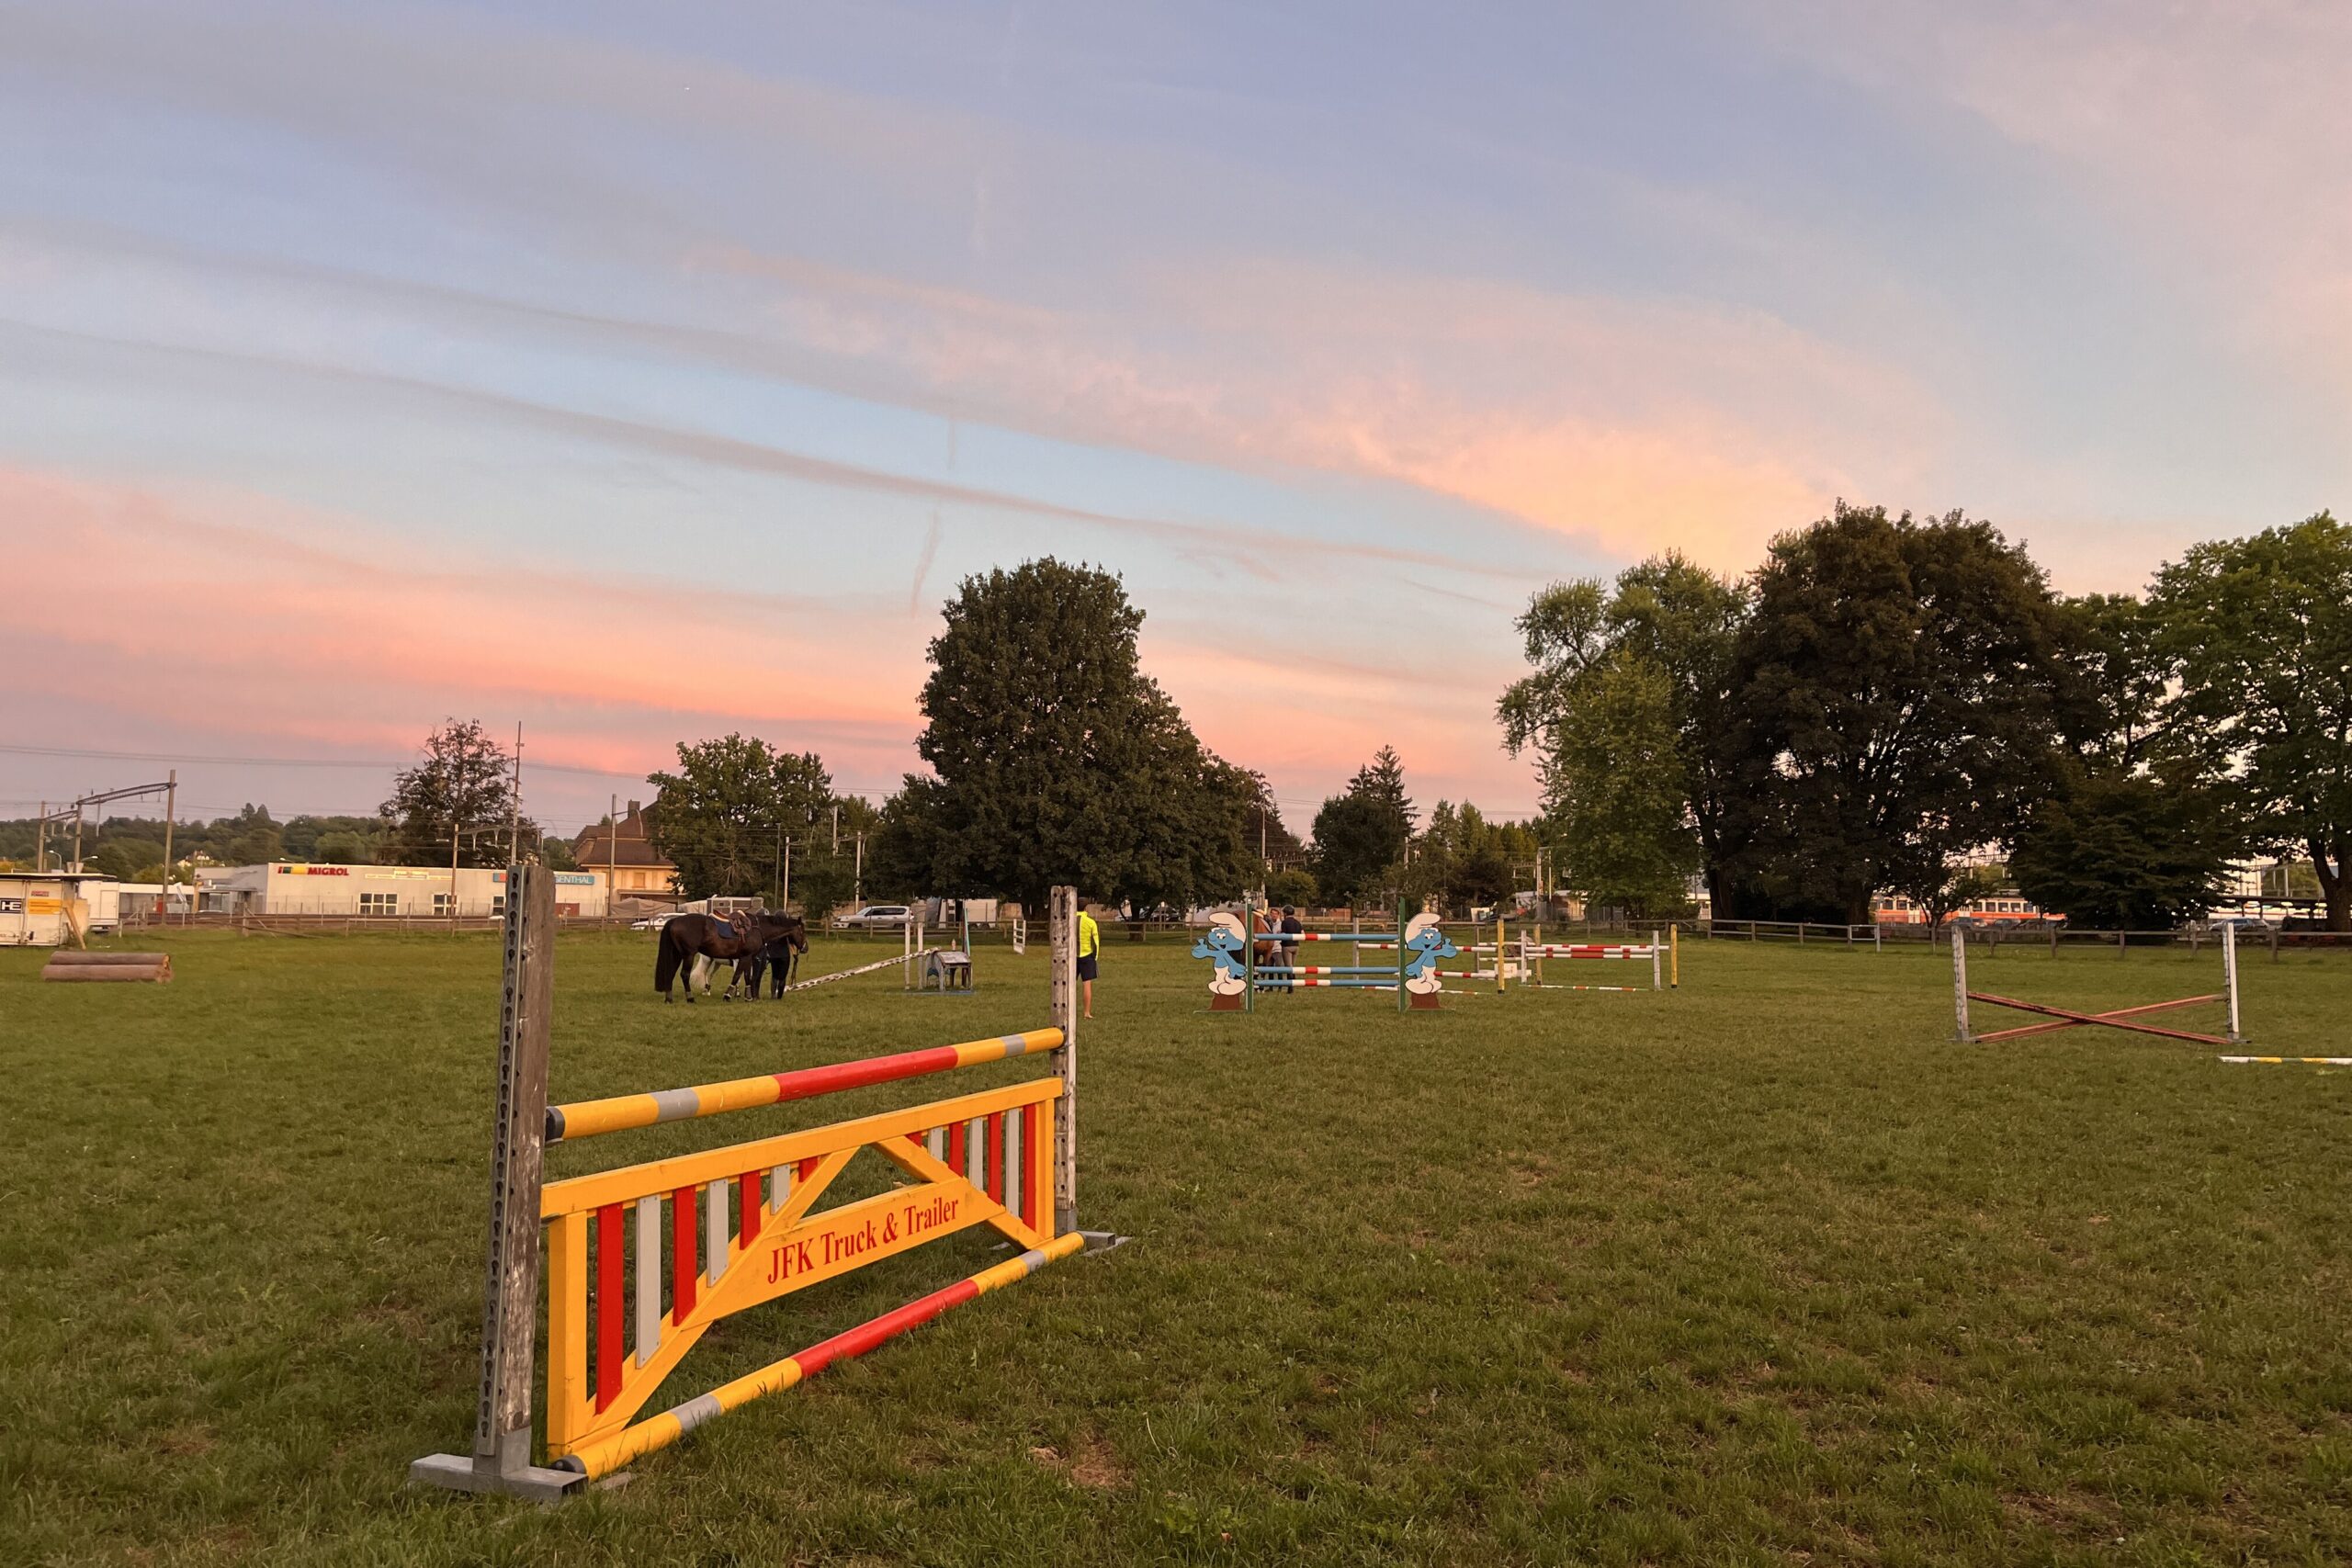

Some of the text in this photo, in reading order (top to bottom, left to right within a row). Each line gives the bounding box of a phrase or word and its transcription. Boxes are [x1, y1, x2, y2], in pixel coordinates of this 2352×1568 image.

[308, 867, 349, 875] MIGROL
[767, 1197, 959, 1284] JFK Truck & Trailer
